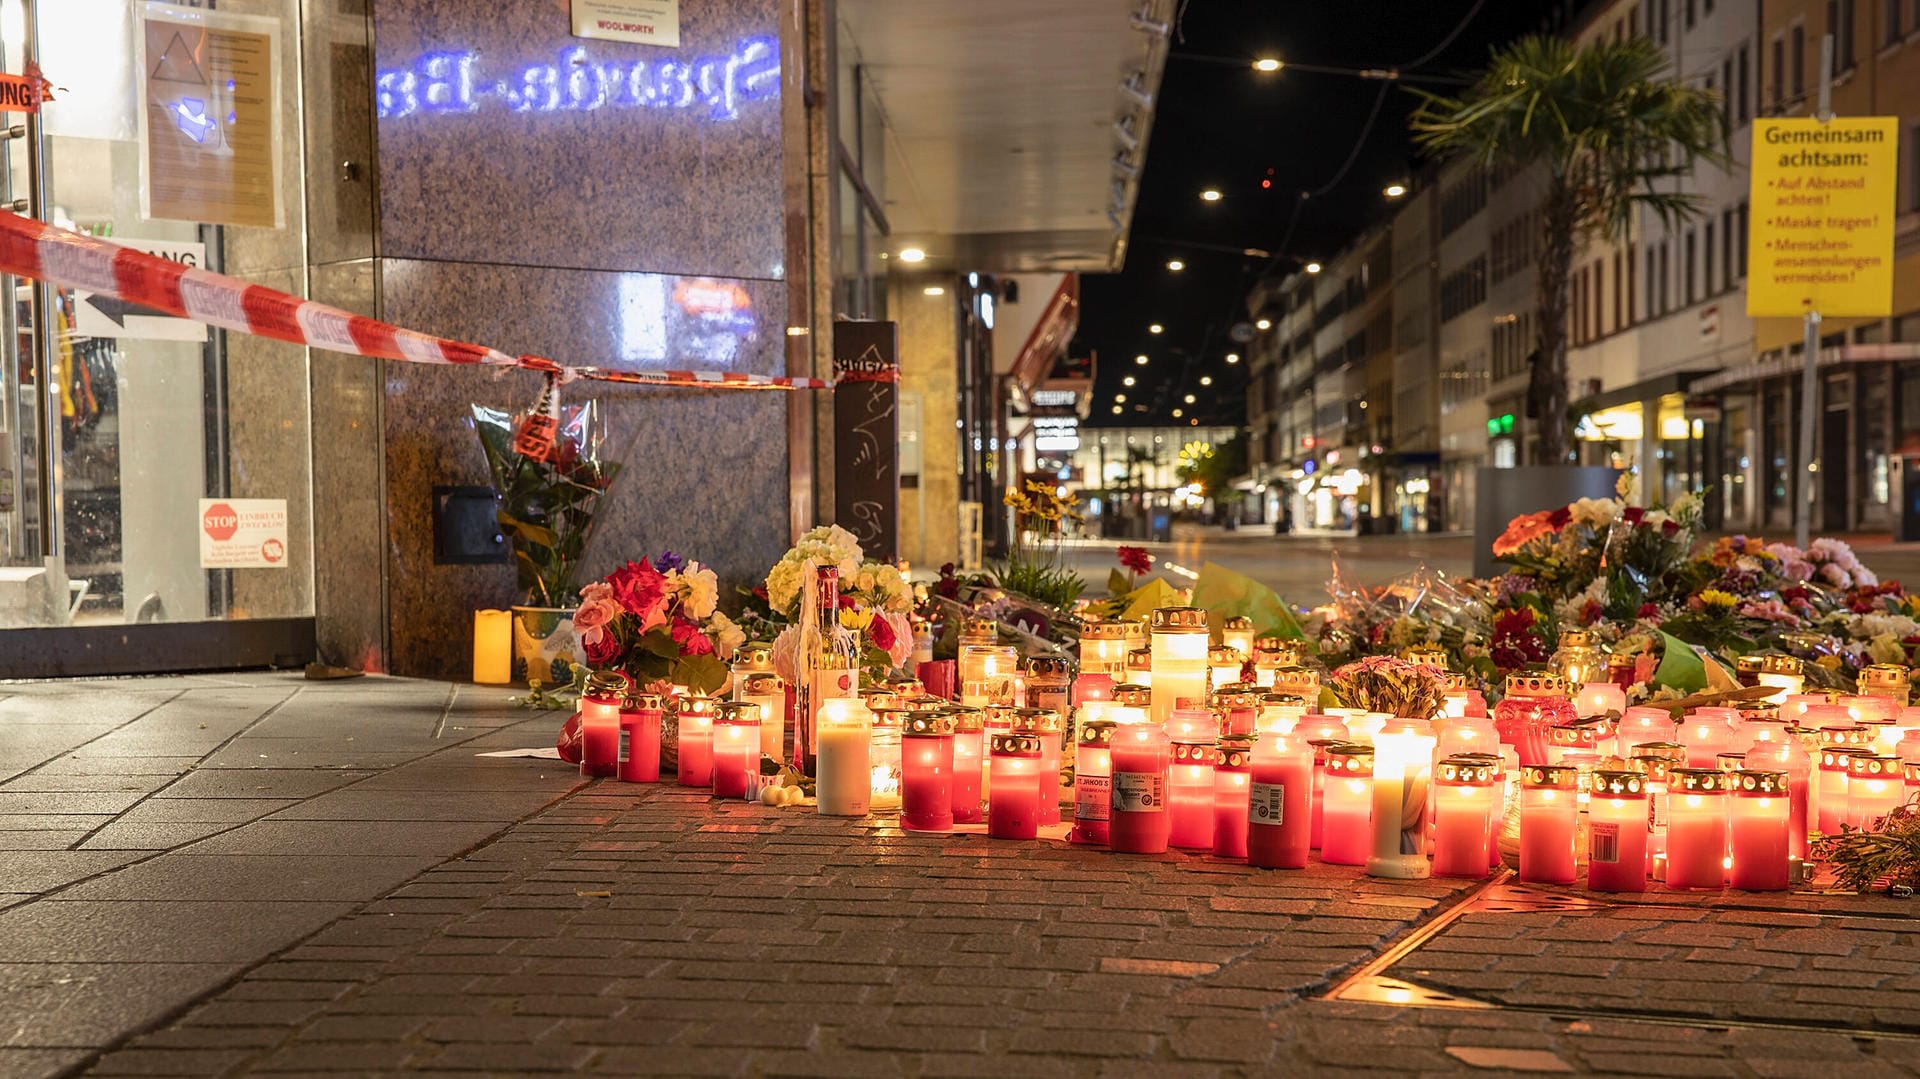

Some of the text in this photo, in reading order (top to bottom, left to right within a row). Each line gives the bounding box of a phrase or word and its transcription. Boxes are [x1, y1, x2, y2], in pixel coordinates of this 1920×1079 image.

[597, 20, 654, 34] WOOLWORTH
[1765, 125, 1884, 144] Gemeinsam
[1778, 149, 1868, 167] achtsam:
[1776, 176, 1865, 189] Auf Abstand
[1775, 216, 1821, 228] Maske
[1774, 238, 1852, 250] Menschen-
[1774, 255, 1881, 270] ansammlungen
[205, 516, 237, 529] STOP
